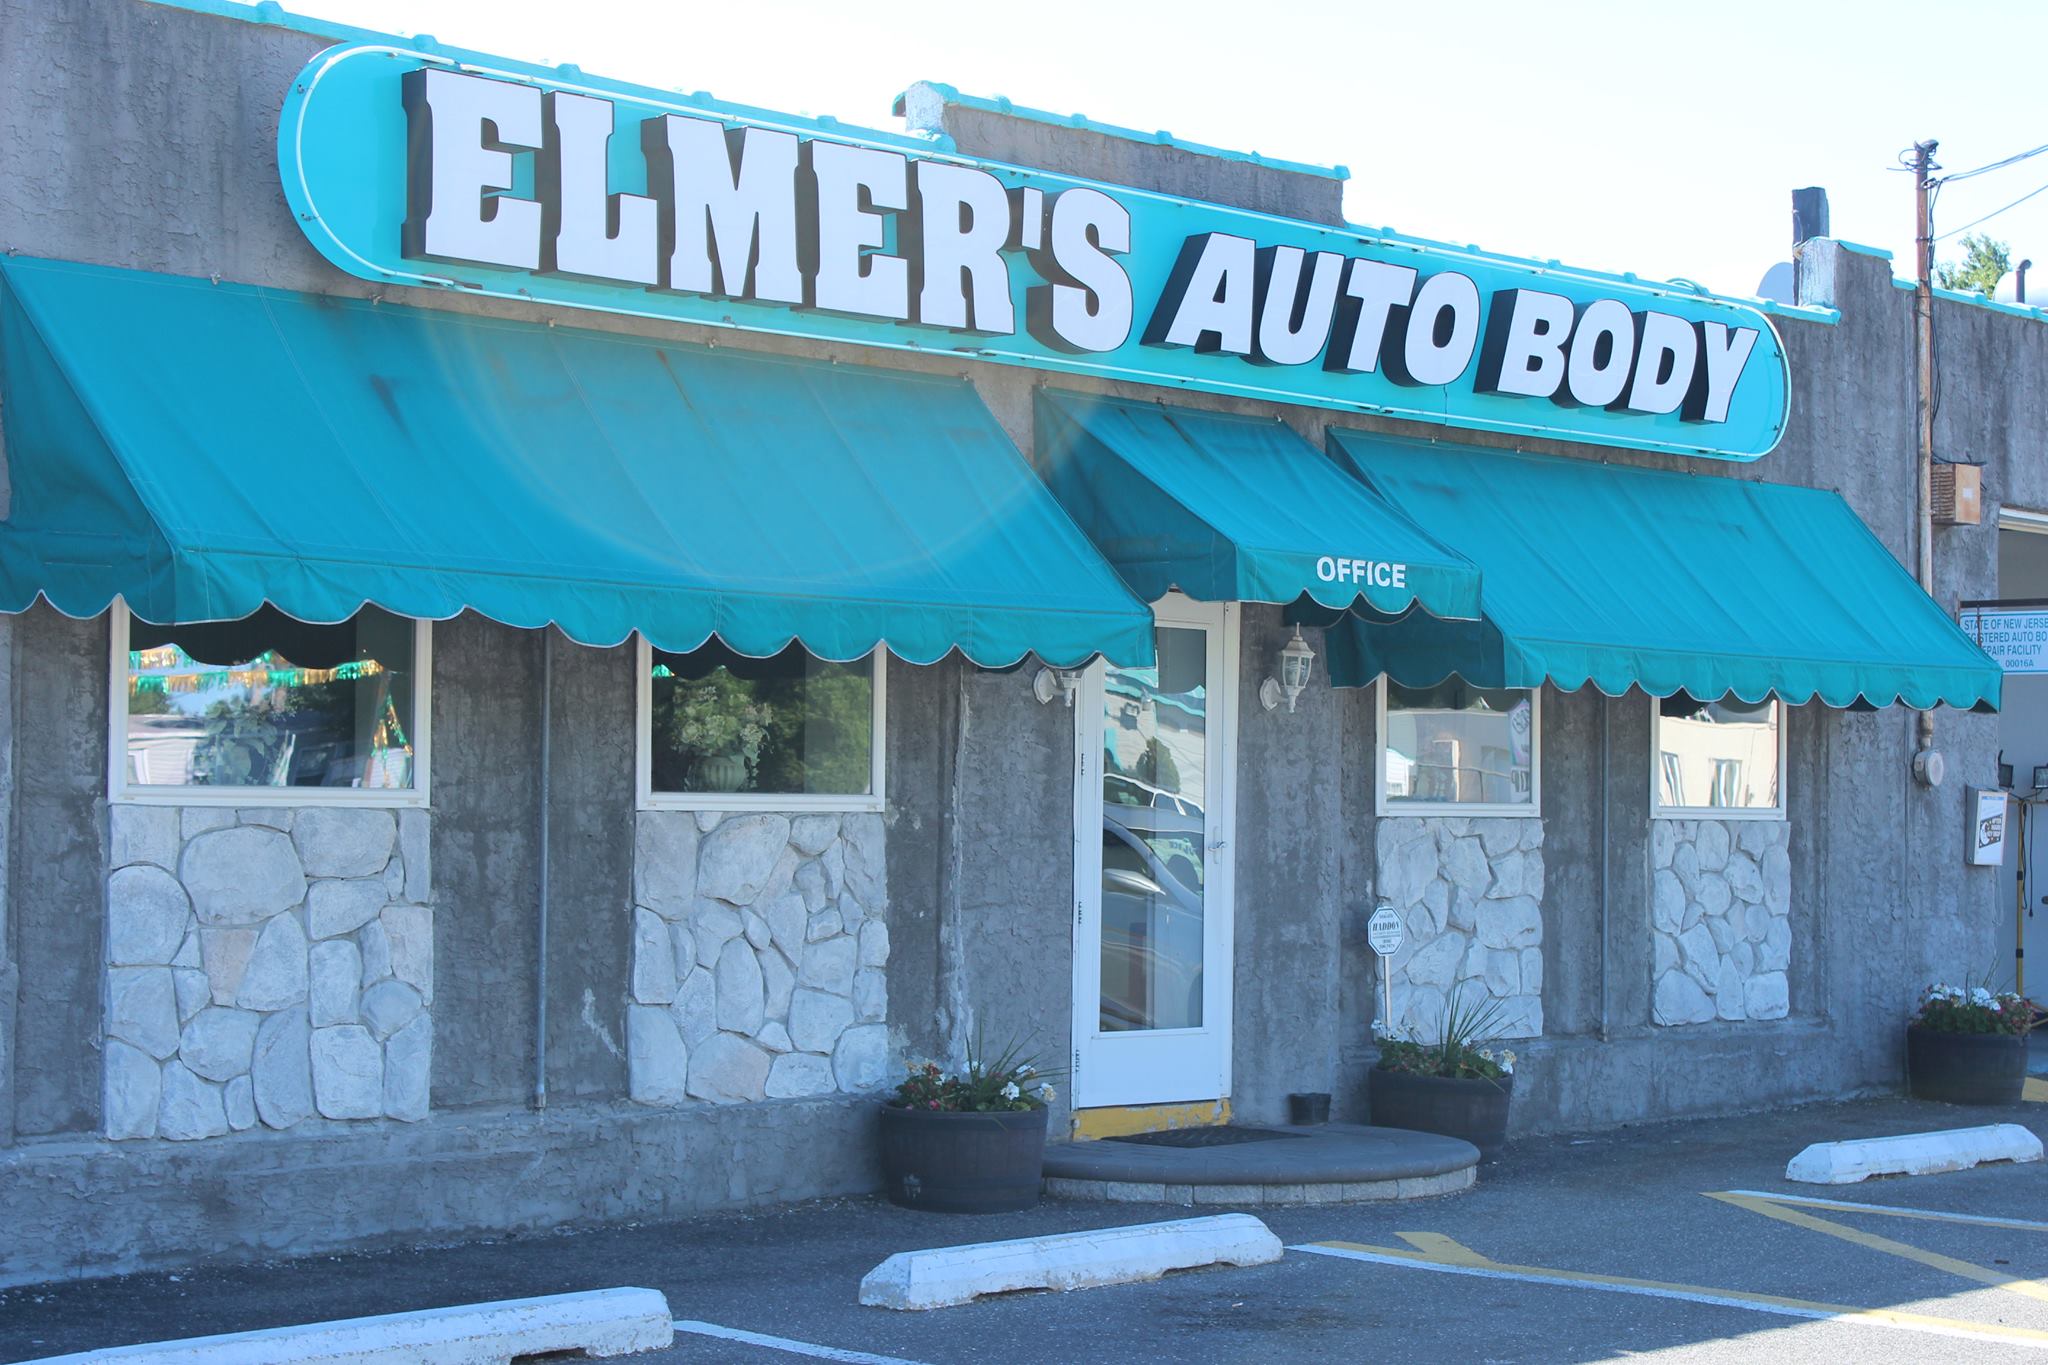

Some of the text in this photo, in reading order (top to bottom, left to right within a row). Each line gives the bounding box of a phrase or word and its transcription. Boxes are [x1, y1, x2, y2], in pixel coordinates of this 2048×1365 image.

[403, 66, 1760, 424] ELMER'S AUTO BODY
[1316, 556, 1407, 589] OFFICE
[1964, 620, 1989, 630] STATE
[1990, 619, 2001, 630] OF
[2003, 618, 2022, 629] NEW
[2011, 631, 2034, 642] AUTO
[2007, 644, 2041, 655] FACILITY
